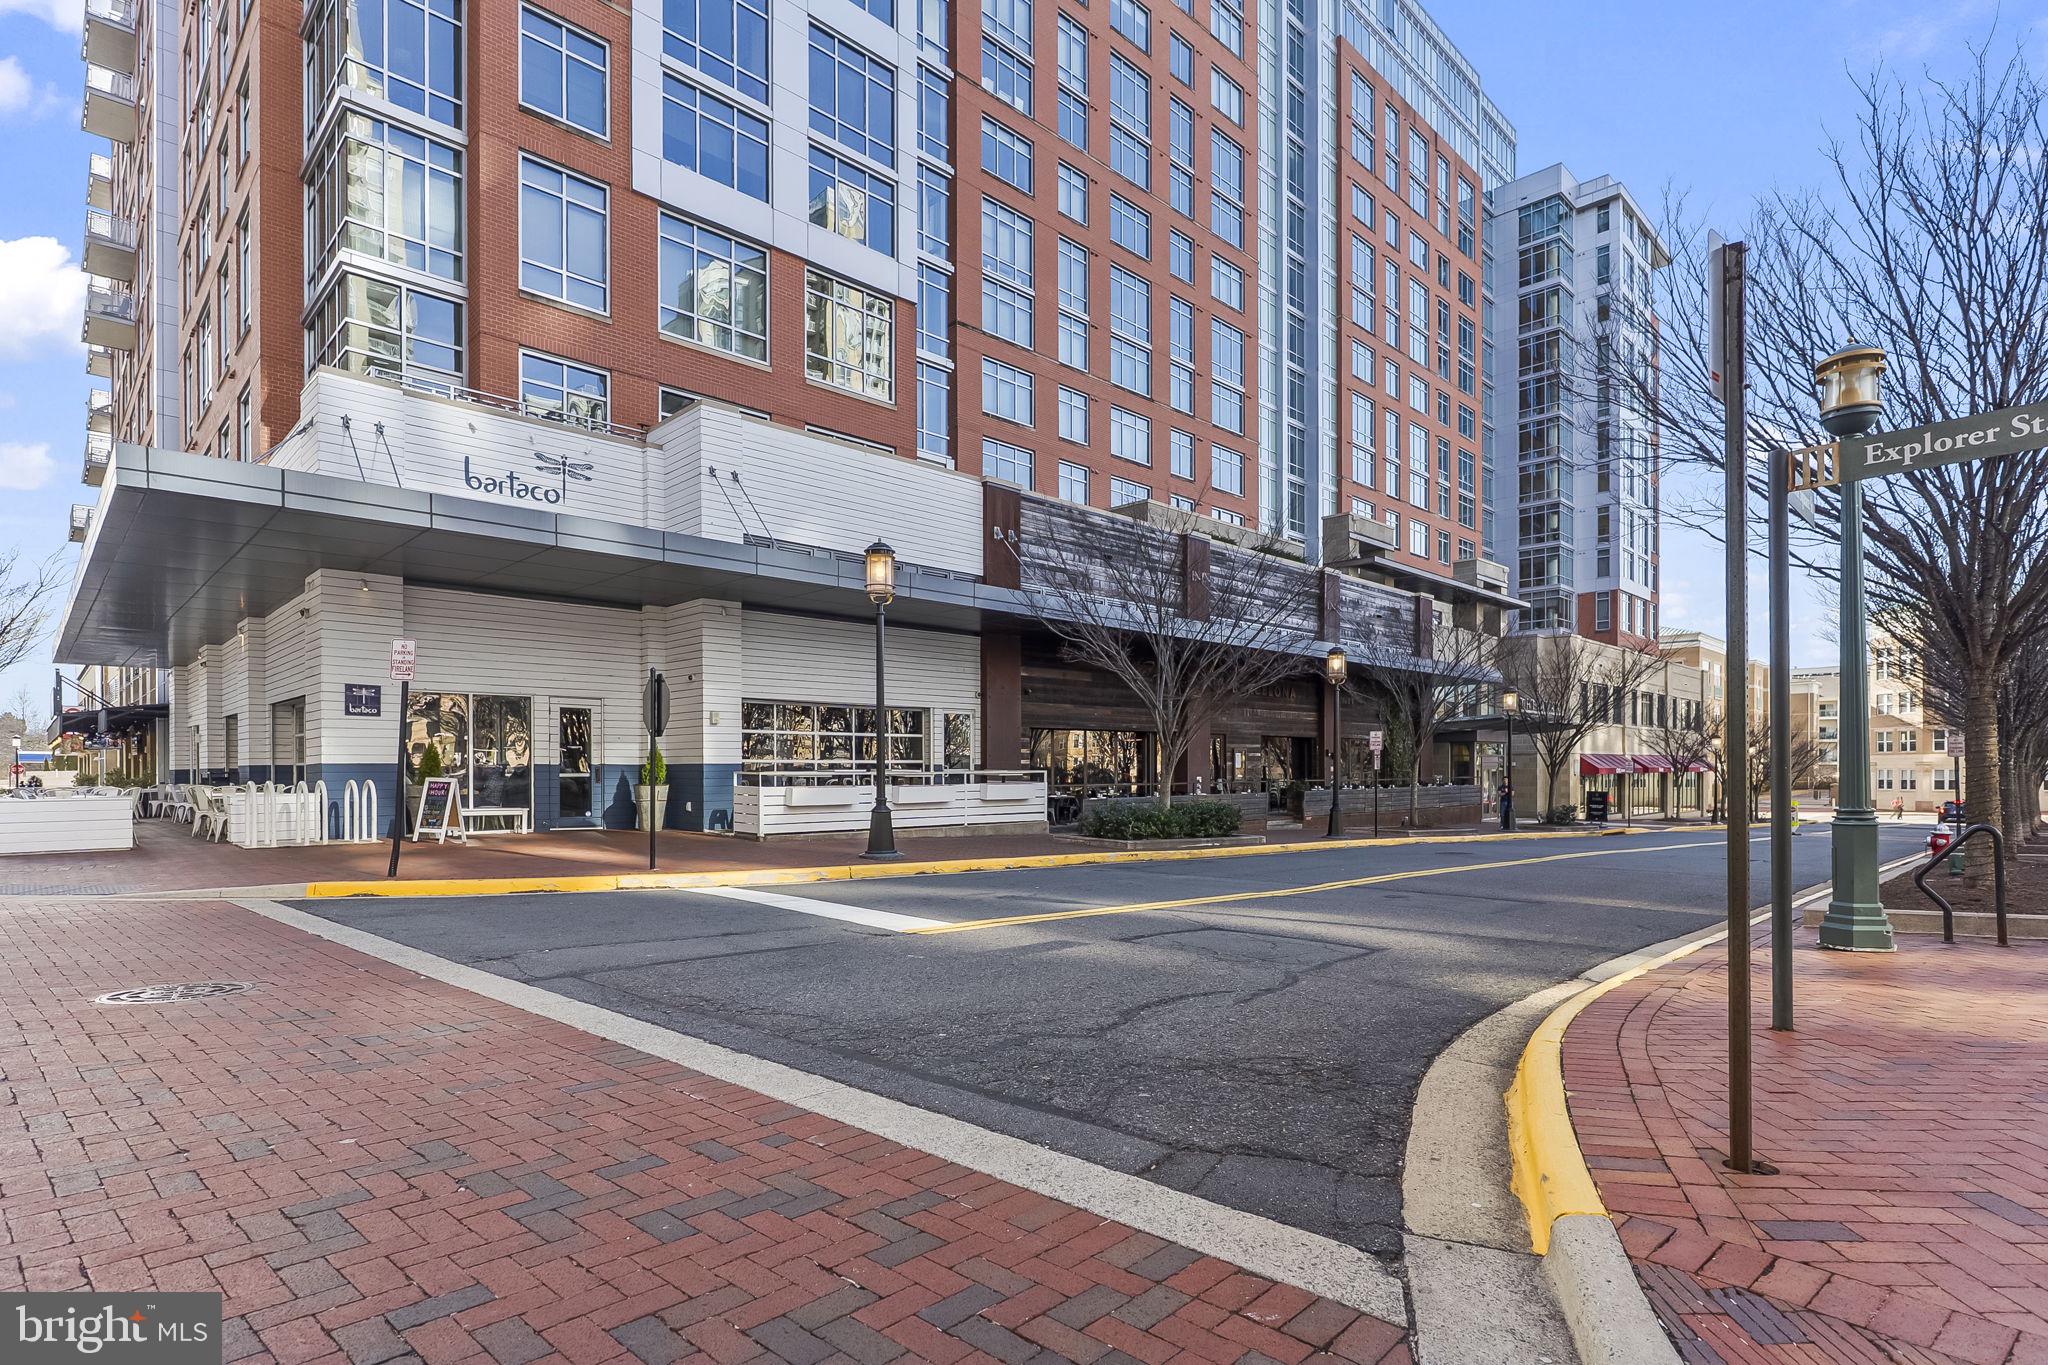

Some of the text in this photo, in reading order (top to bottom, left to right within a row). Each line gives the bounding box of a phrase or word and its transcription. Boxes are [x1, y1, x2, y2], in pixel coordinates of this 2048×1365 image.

[1864, 427, 2000, 466] Explorer
[464, 455, 560, 504] bartaco
[349, 703, 378, 714] bartaco
